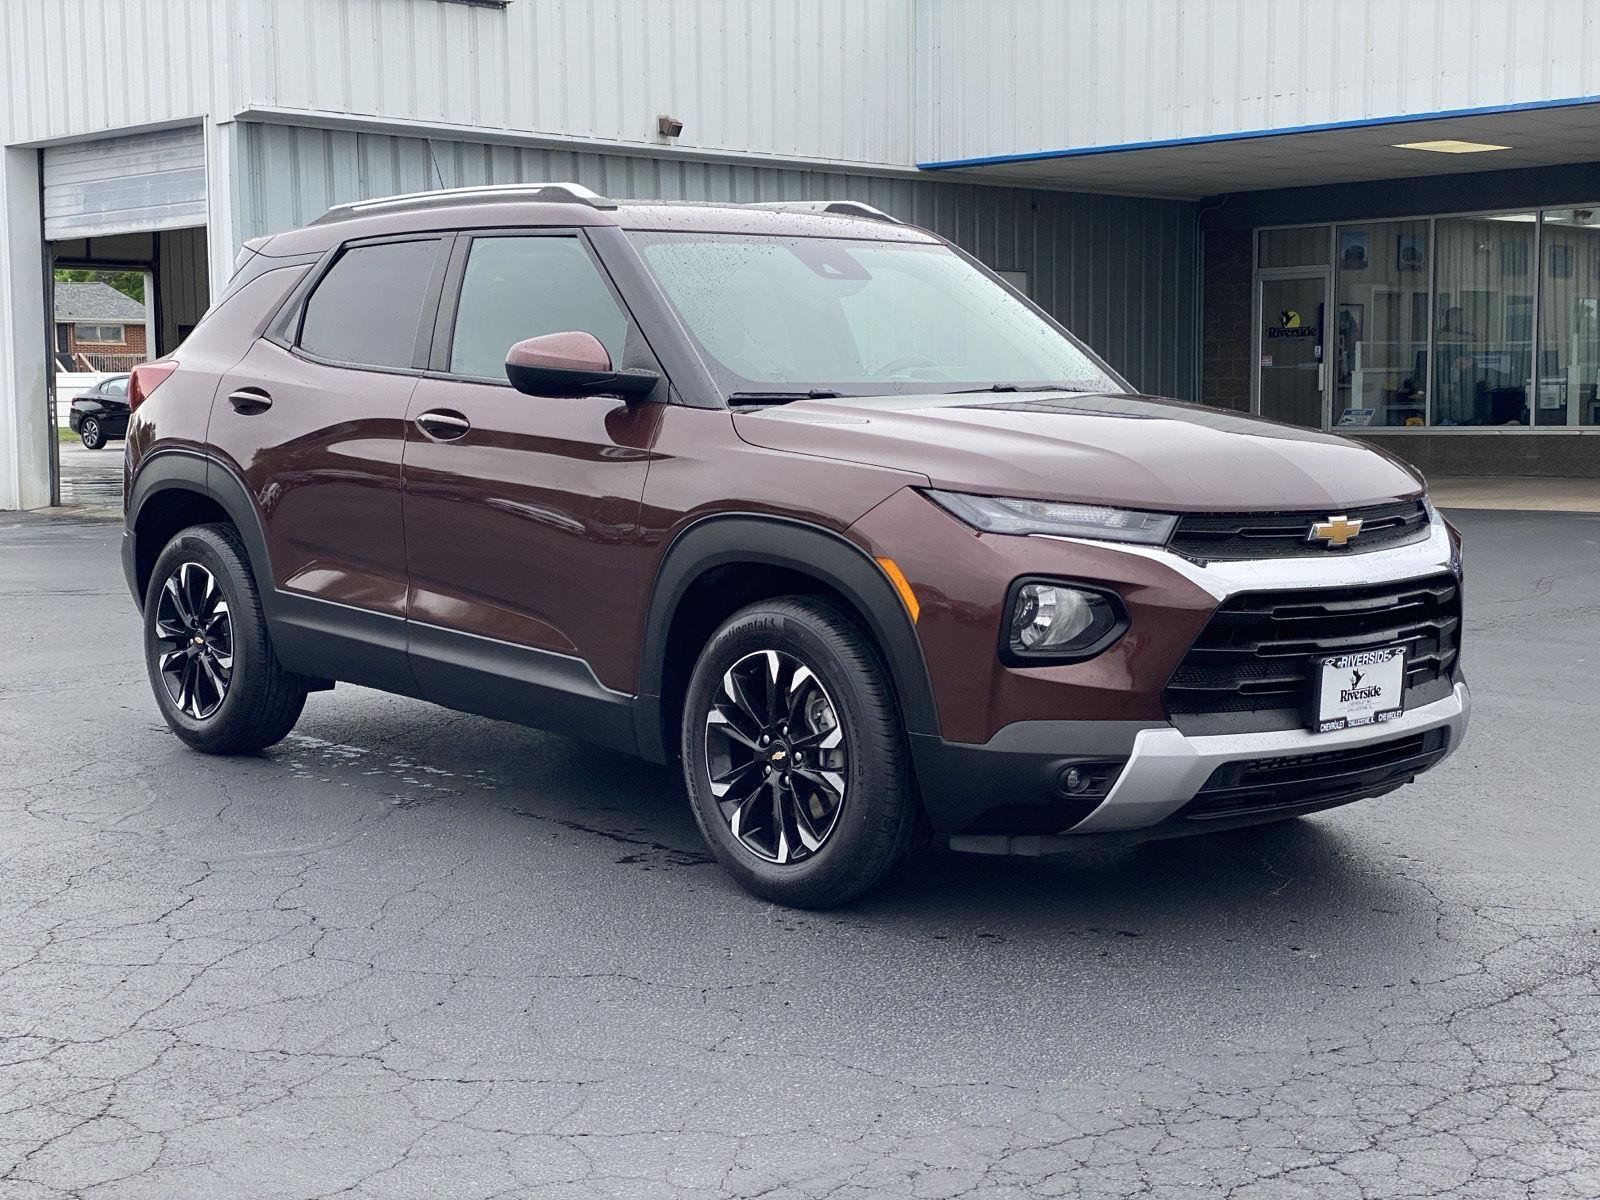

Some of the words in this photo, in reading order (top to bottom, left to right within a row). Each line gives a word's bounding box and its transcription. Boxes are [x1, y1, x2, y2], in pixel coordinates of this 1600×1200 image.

[1267, 326, 1318, 338] Riverside
[1341, 650, 1390, 668] RIVERSIDE
[1340, 685, 1382, 702] Riverside
[1320, 720, 1345, 733] CHEVROLET
[1378, 710, 1402, 722] CHEVROLET
